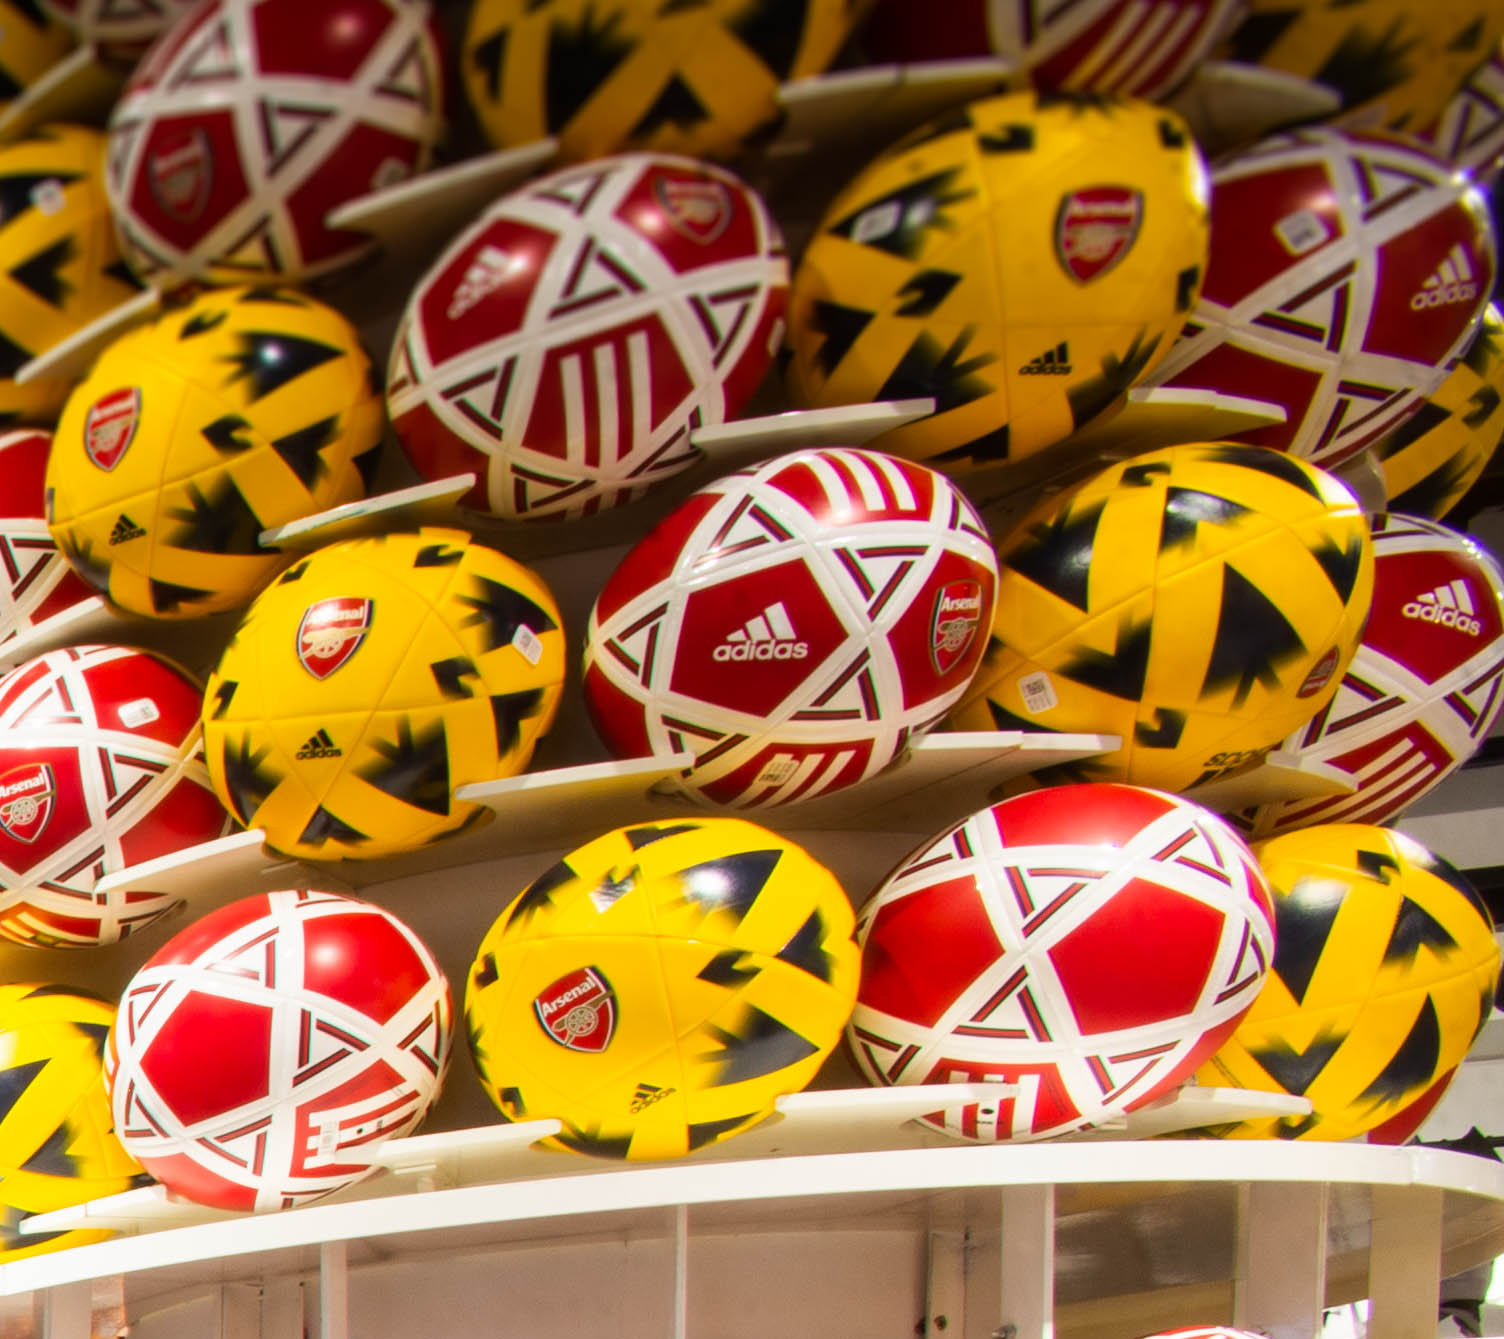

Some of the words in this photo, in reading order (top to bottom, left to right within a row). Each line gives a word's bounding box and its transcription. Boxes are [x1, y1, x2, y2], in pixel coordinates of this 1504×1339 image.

[941, 595, 982, 615] Arsenal
[1402, 600, 1482, 637] adidas
[711, 637, 810, 662] adidas
[295, 747, 342, 761] adidas
[542, 973, 597, 1015] Arsenal
[629, 1086, 677, 1114] adidas
